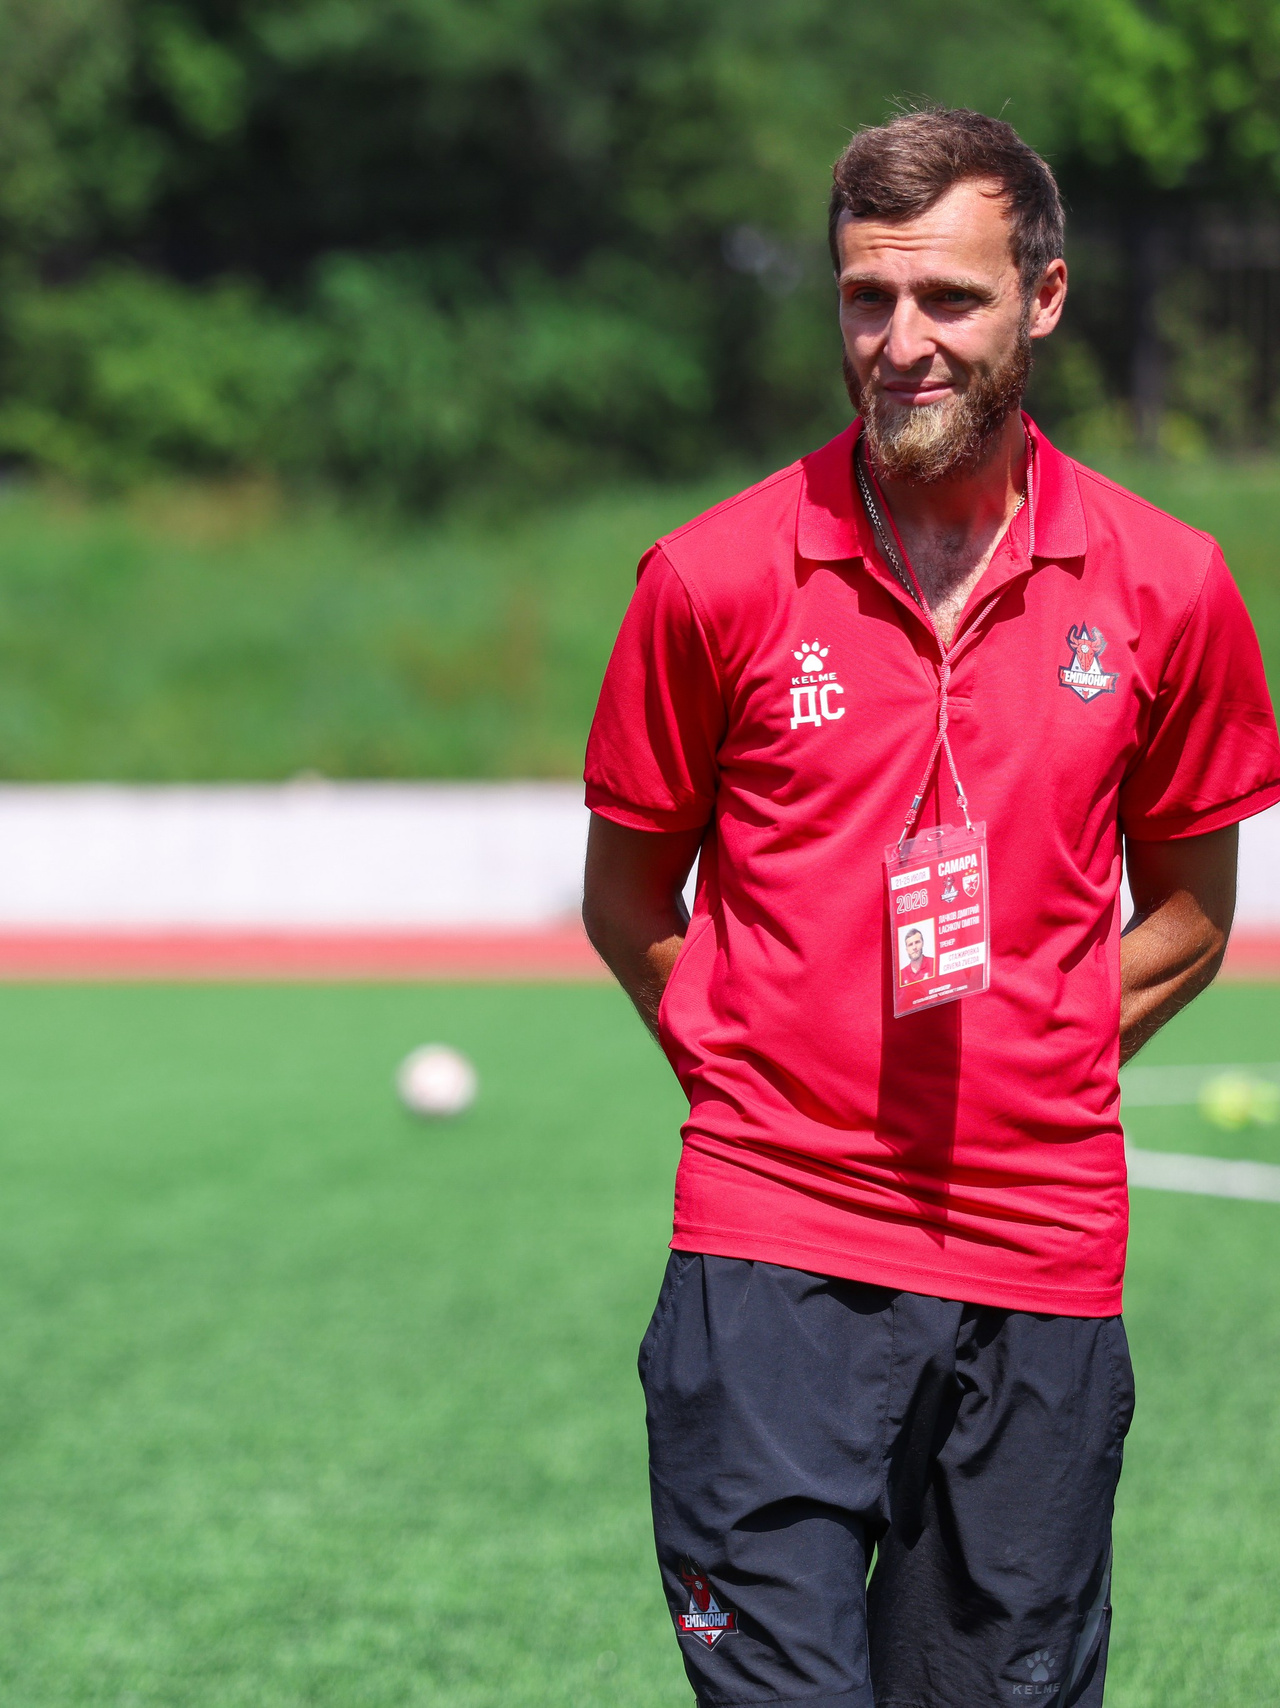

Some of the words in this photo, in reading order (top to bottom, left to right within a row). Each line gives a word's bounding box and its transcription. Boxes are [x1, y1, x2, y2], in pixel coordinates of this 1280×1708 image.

[791, 672, 838, 686] KELME
[789, 682, 846, 730] ДС
[937, 853, 978, 877] САМАРА
[896, 888, 929, 915] 2026
[1012, 1682, 1061, 1695] KELME
